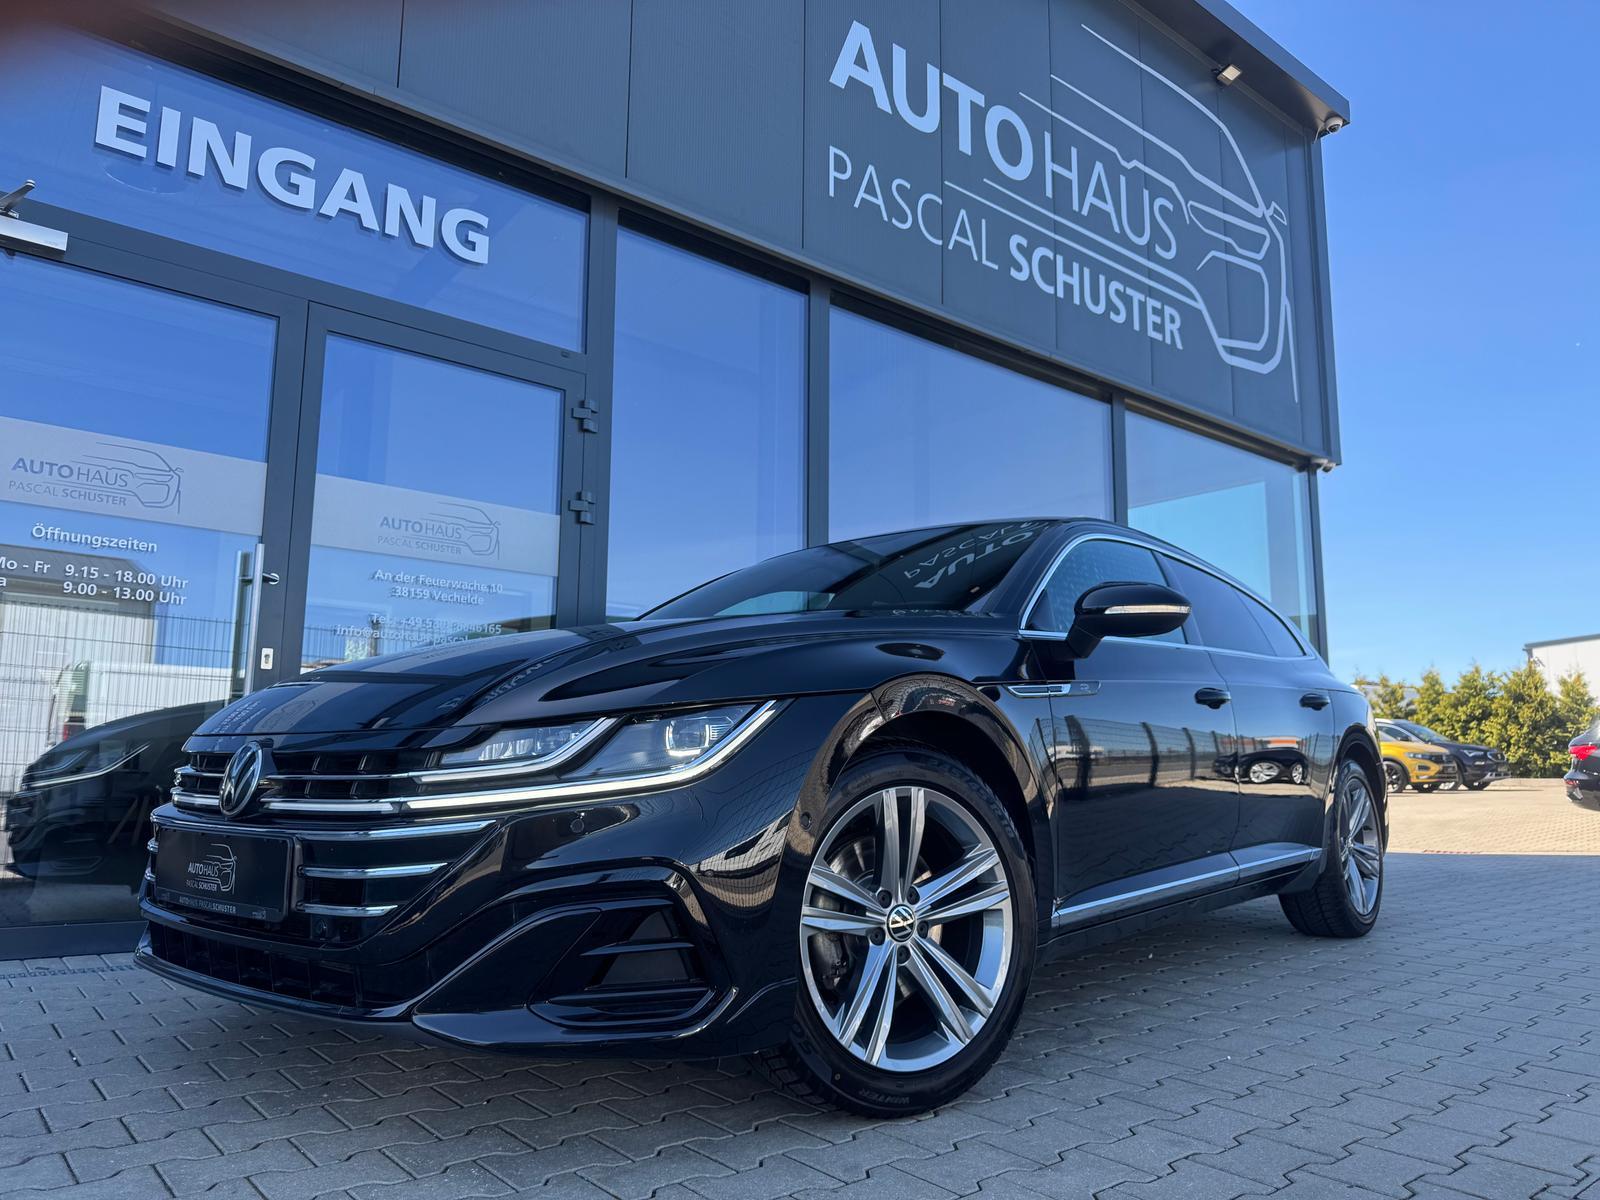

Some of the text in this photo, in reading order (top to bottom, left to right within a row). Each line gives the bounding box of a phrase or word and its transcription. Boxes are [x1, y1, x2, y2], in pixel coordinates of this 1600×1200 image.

[95, 85, 489, 264] EINGANG
[829, 145, 1183, 350] PASCAL SCHUSTER
[11, 457, 129, 488] AUTOHAUS
[8, 480, 127, 506] PASCAL SCHUSTER
[32, 523, 157, 552] Öffnungszeiten
[380, 516, 462, 539] AUTOHAUS
[377, 535, 462, 555] PASCAL SCHUSTER
[34, 560, 51, 573] Fr
[65, 564, 99, 578] 9.15
[115, 569, 156, 585] 18.00
[161, 575, 188, 589] Uhr
[375, 569, 392, 580] An
[395, 571, 415, 583] der
[420, 574, 488, 592] Feuerwache
[63, 581, 97, 596] 9.00
[113, 586, 154, 602] 13.00
[159, 591, 187, 606] Uhr
[395, 585, 485, 605] 38159 Vechelde
[187, 862, 219, 877] AUTOHAUS
[198, 881, 217, 892] SCHUSTER
[213, 902, 237, 913] SCHUSTER
